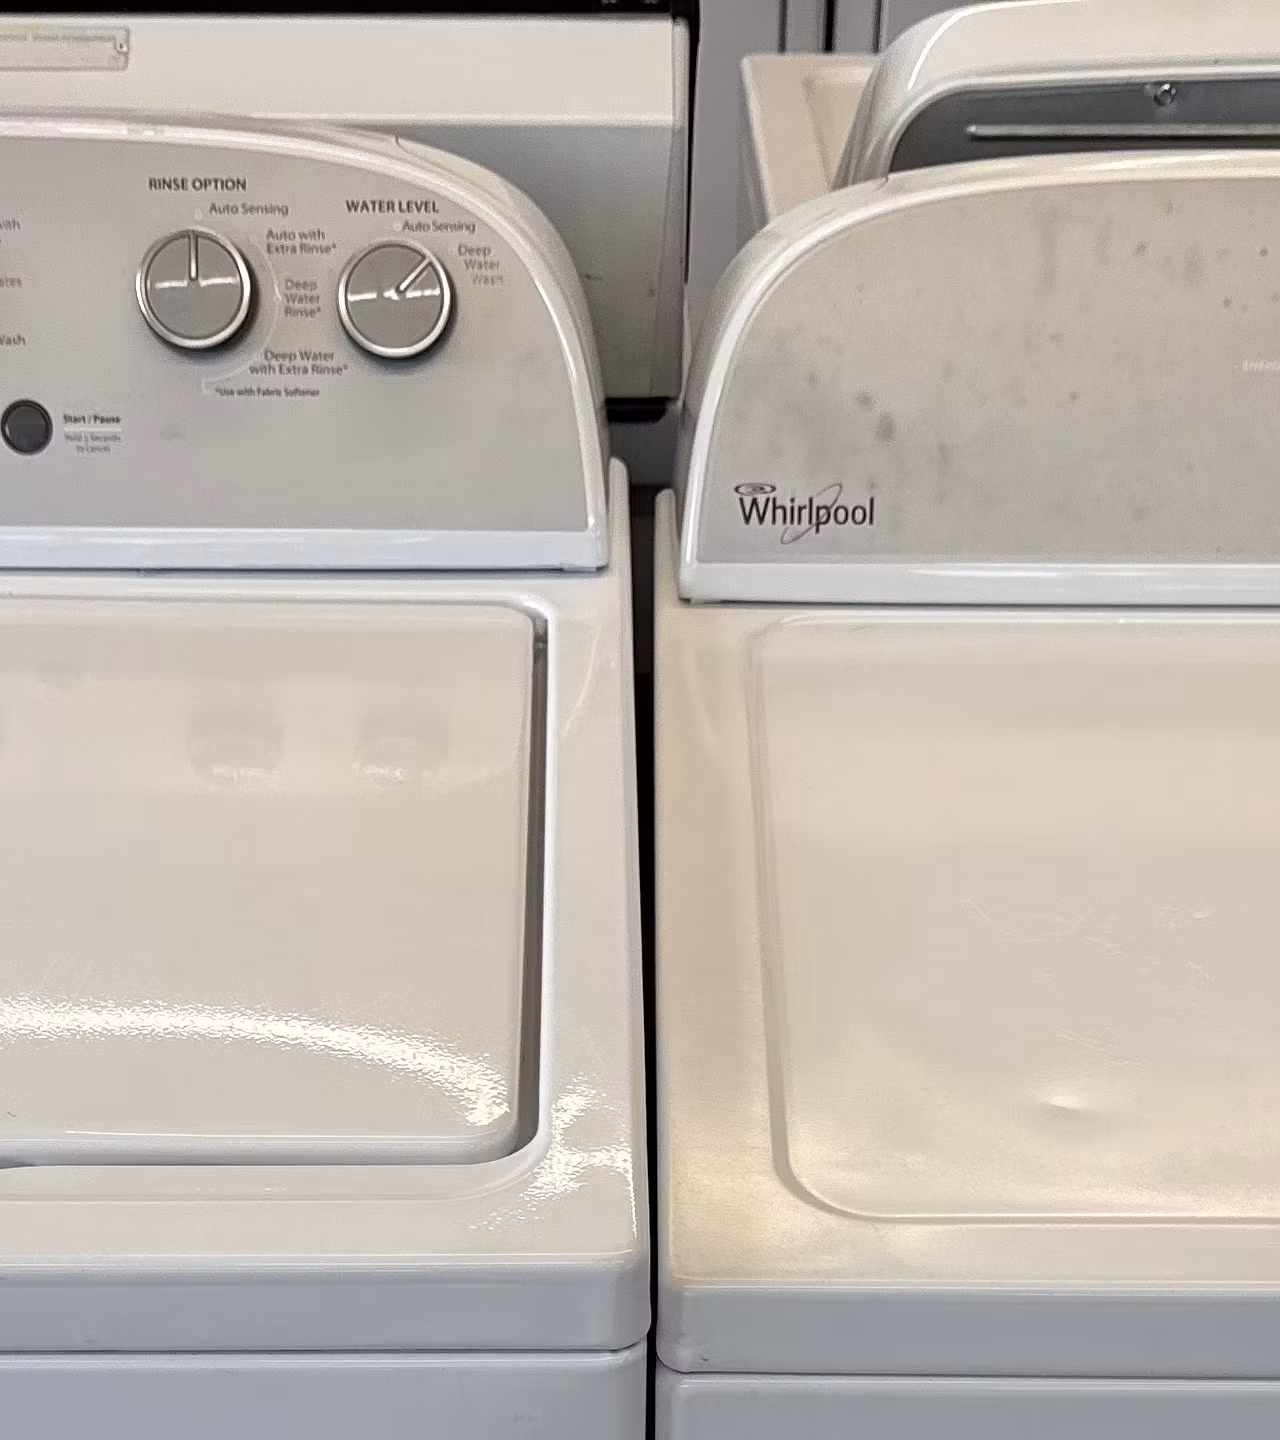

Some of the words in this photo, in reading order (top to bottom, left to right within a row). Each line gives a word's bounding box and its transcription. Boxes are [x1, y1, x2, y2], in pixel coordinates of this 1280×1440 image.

[148, 178, 188, 191] RINSE
[191, 178, 247, 191] OPTION
[209, 203, 239, 215] Auto
[241, 203, 289, 217] Sensing
[346, 200, 395, 213] WATER
[398, 200, 439, 213] LEVEL
[402, 220, 430, 232] Auto
[432, 221, 476, 234] Sensing
[266, 230, 296, 240] Auto
[298, 229, 326, 241] with
[267, 243, 297, 254] Extra
[458, 244, 492, 259] Deep
[285, 279, 317, 291] Deep
[285, 293, 320, 304] Water
[264, 351, 296, 364] Deep
[298, 350, 335, 362] Water
[249, 363, 276, 375] with
[278, 363, 308, 375] Extra
[63, 414, 86, 424] Start
[737, 490, 876, 538] Whirlpool
